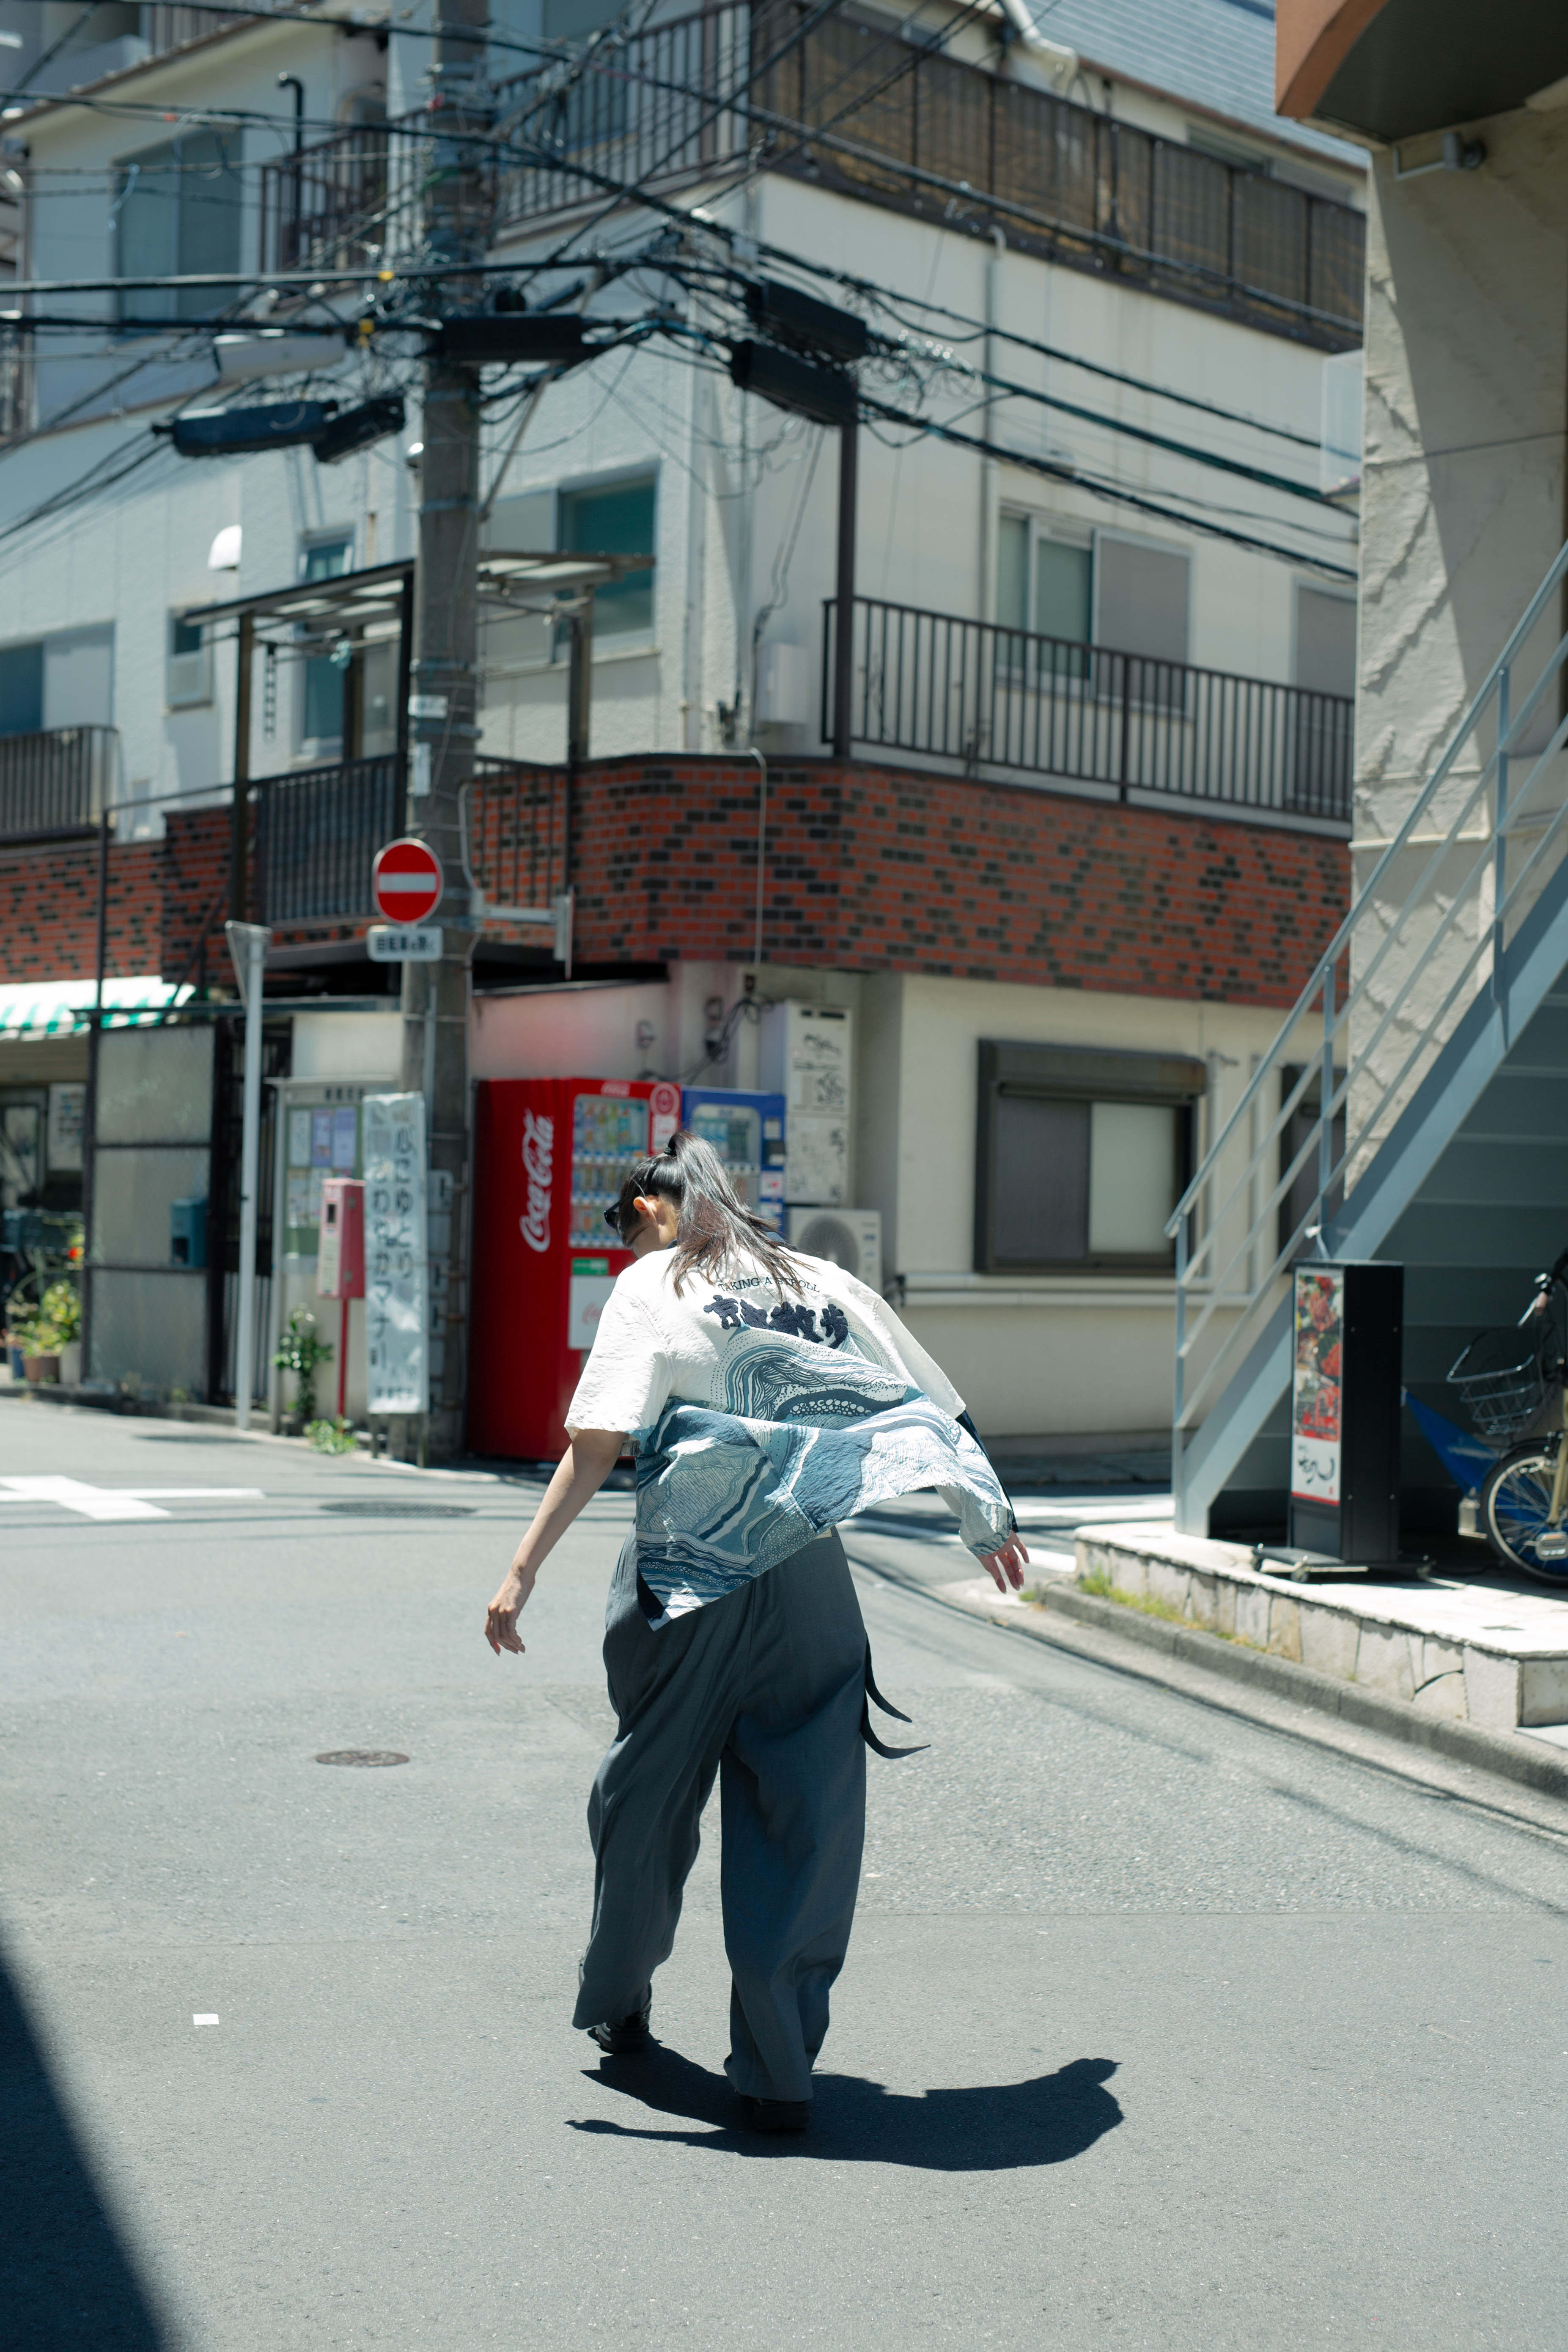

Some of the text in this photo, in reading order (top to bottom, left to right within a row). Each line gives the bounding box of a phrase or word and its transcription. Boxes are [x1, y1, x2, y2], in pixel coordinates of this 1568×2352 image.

[395, 1124, 418, 1279] 心にゆとり
[718, 1277, 760, 1291] TAKING
[764, 1276, 772, 1285] A
